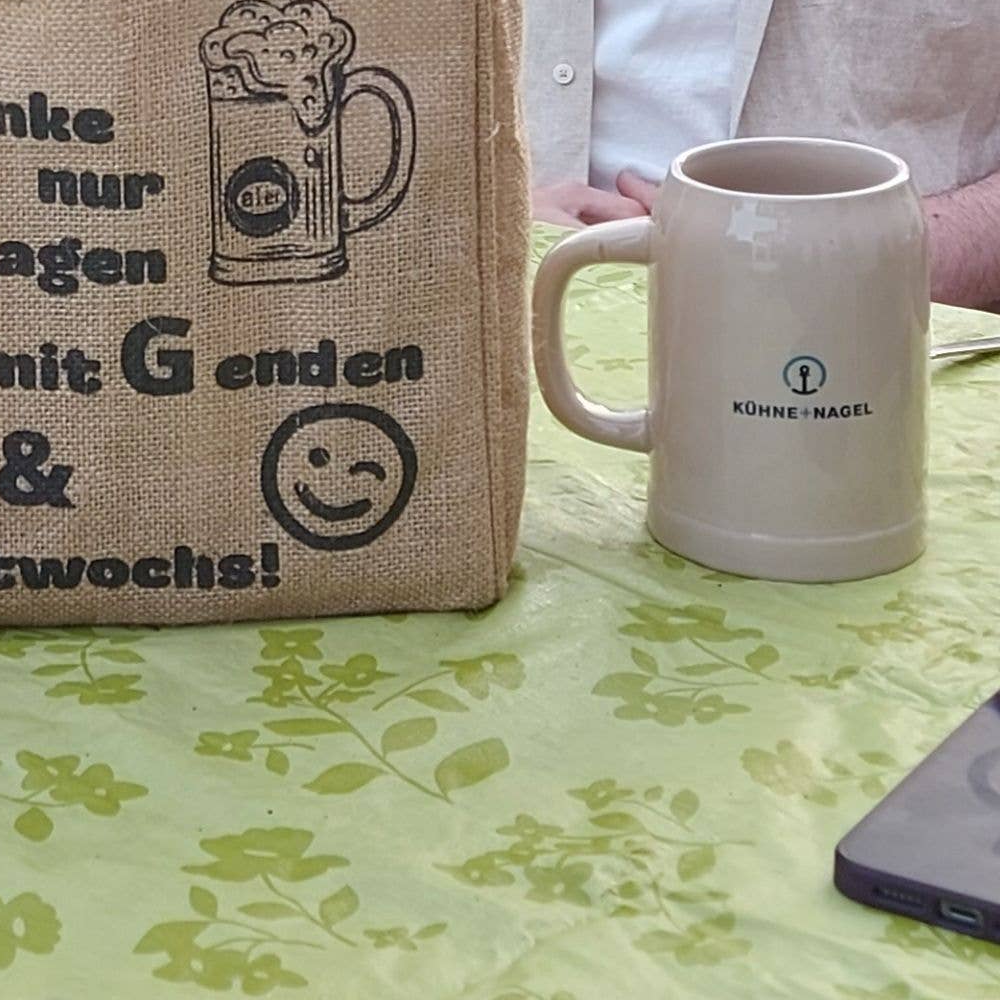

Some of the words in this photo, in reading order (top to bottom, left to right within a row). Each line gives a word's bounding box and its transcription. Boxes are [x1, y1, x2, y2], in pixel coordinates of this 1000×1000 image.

[37, 168, 165, 210] nur
[119, 315, 195, 396] G
[213, 339, 425, 391] enden
